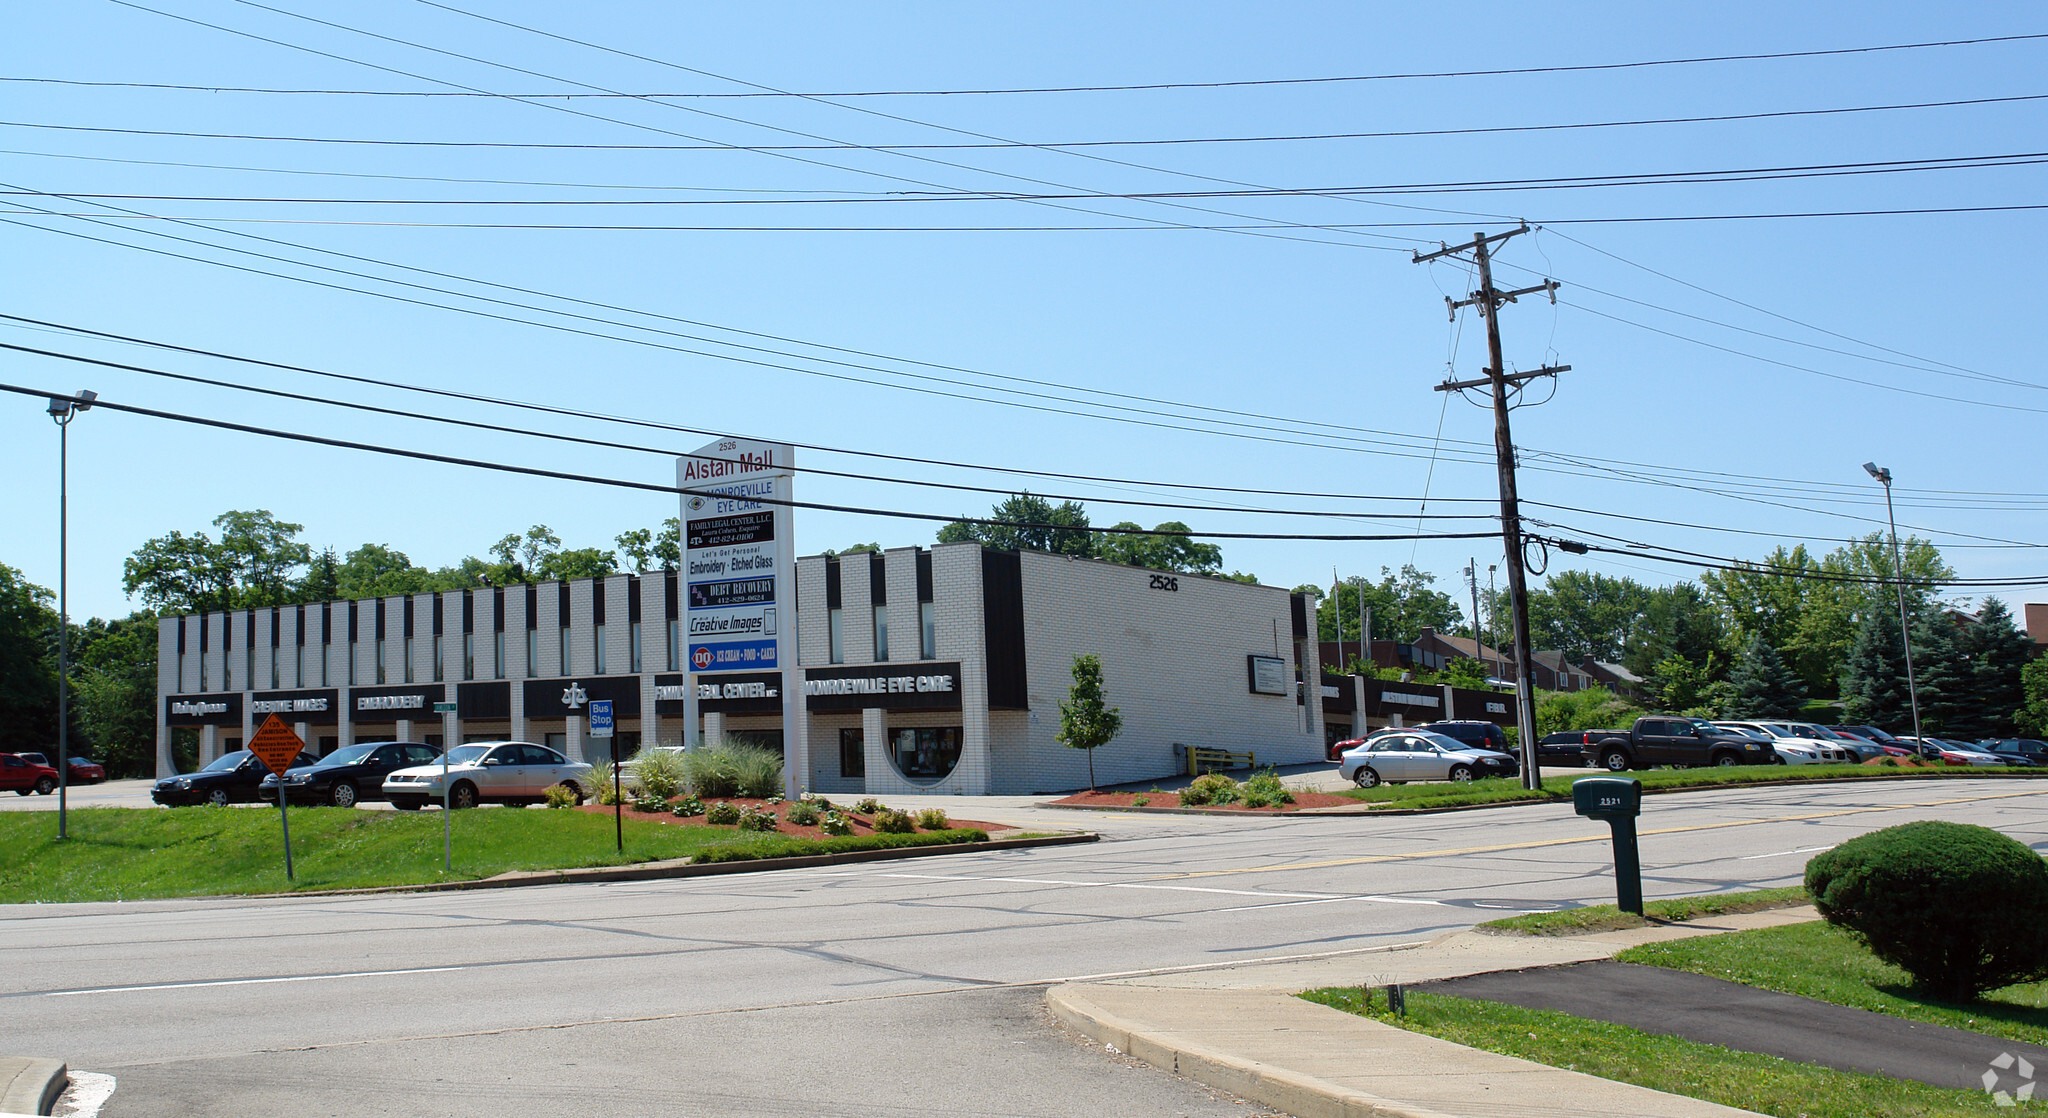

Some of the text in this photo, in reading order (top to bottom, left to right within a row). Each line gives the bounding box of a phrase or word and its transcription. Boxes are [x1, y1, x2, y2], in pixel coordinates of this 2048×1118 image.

[719, 441, 737, 452] 2526
[684, 449, 773, 481] Alstan Mall
[706, 481, 773, 502] MONROEVILLE
[717, 497, 762, 513] EYE CARE
[690, 520, 711, 531] FAMILY
[711, 518, 730, 529] LEGAL
[702, 546, 760, 559] Let's Get Personal
[690, 554, 773, 576] Embroidery Etched Glass
[710, 580, 772, 597] DEBT RECOVERY
[1150, 574, 1179, 592] 2526
[690, 615, 762, 633] Creative Images
[695, 652, 712, 664] DQ
[655, 685, 683, 700] FAMIL
[723, 682, 766, 699] CENTER
[805, 675, 953, 696] MONROEVILLE EYE CARE
[358, 695, 425, 711] EMBROIDERY
[592, 704, 609, 713] Bus
[591, 715, 611, 726] Stop
[1600, 797, 1621, 805] 2521
